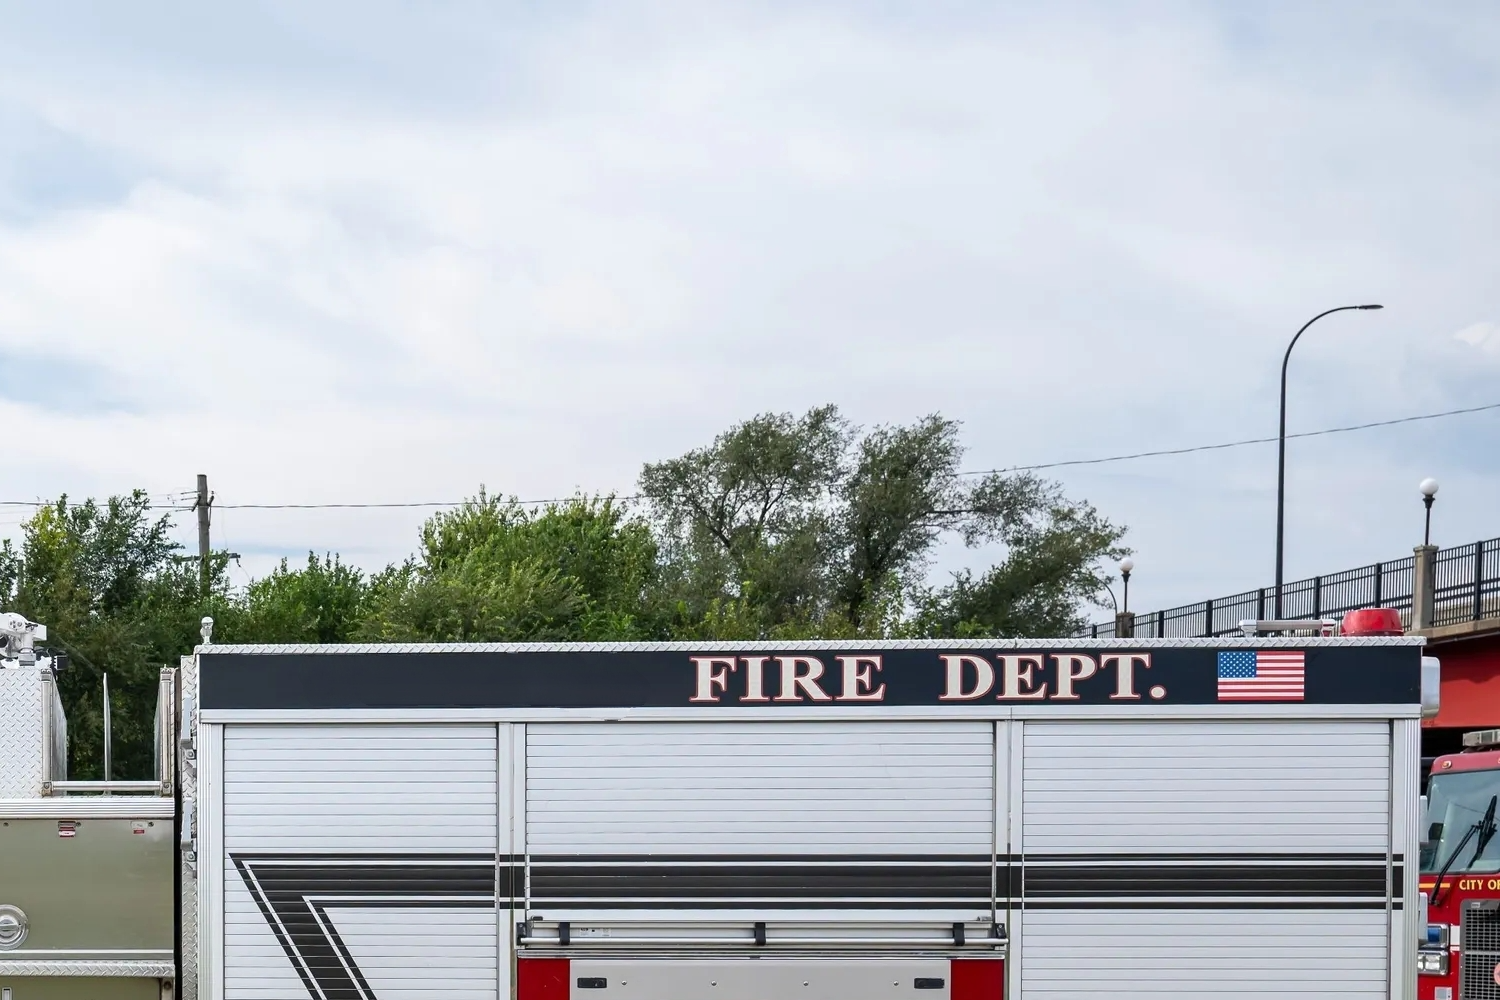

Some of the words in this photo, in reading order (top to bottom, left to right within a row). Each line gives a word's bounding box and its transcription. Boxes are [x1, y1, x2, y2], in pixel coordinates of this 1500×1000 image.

[690, 655, 887, 702] FIRE
[938, 652, 1168, 701] DEPT.
[1459, 879, 1484, 890] CITY
